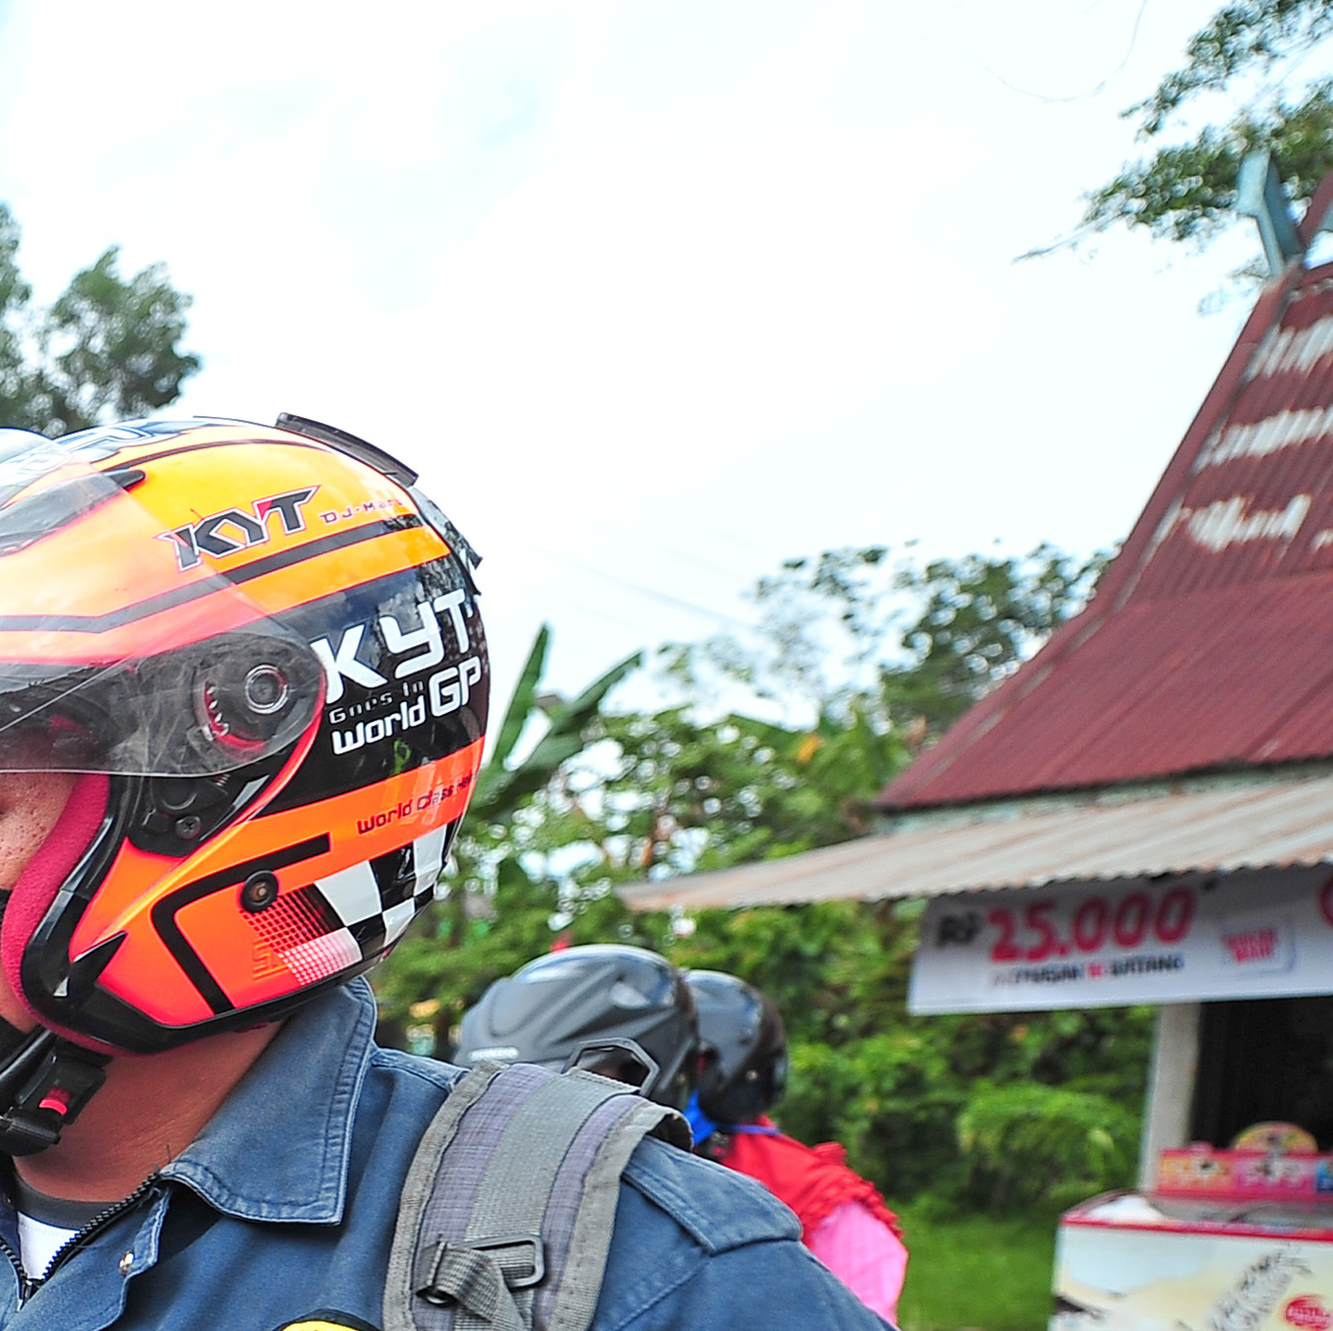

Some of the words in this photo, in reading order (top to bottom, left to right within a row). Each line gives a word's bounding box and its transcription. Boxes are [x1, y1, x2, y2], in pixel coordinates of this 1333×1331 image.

[155, 485, 321, 573] KYT
[310, 588, 474, 704] KYT
[332, 695, 426, 755] World
[429, 656, 482, 717] GP
[357, 799, 413, 835] World
[988, 888, 1196, 961] 25.000
